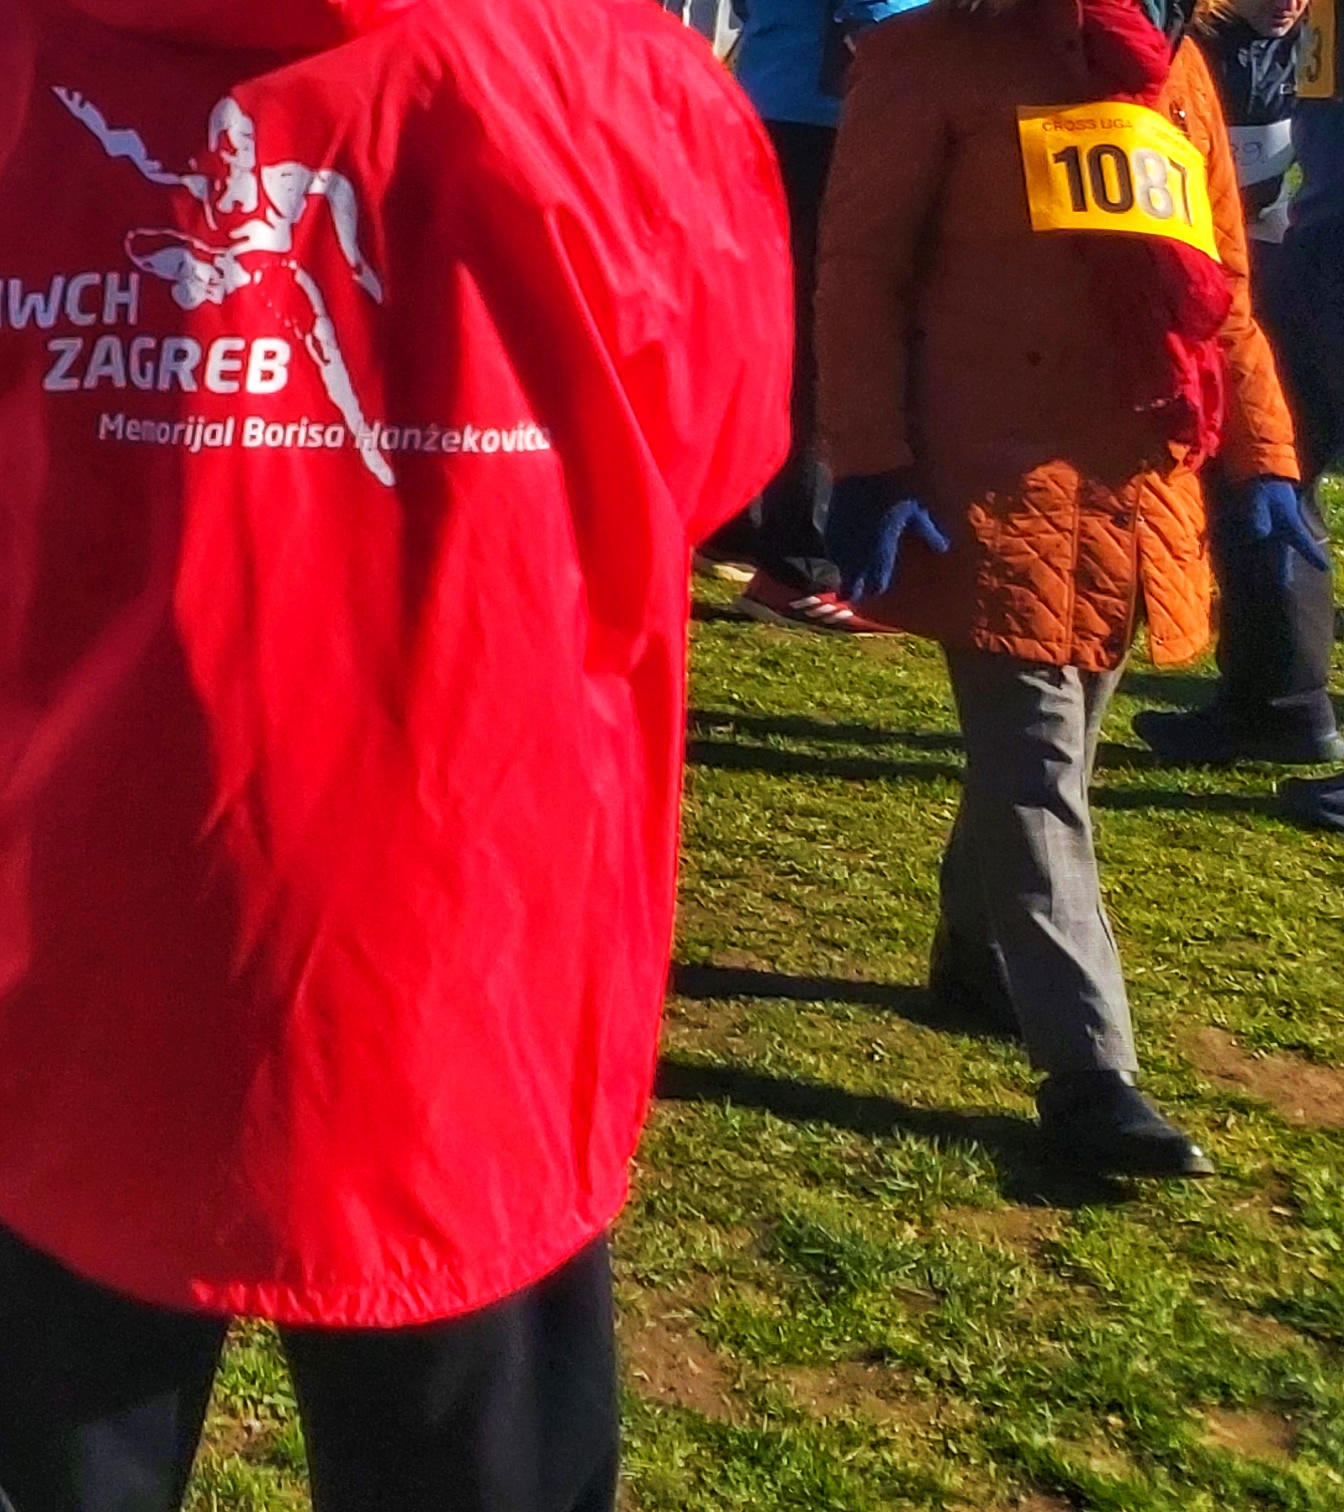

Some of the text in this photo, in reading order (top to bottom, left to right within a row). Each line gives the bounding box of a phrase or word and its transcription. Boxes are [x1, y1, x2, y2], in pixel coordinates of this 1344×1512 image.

[43, 336, 291, 394] ZAGREB
[98, 413, 235, 454] Memorijal
[242, 414, 345, 449] Borisa
